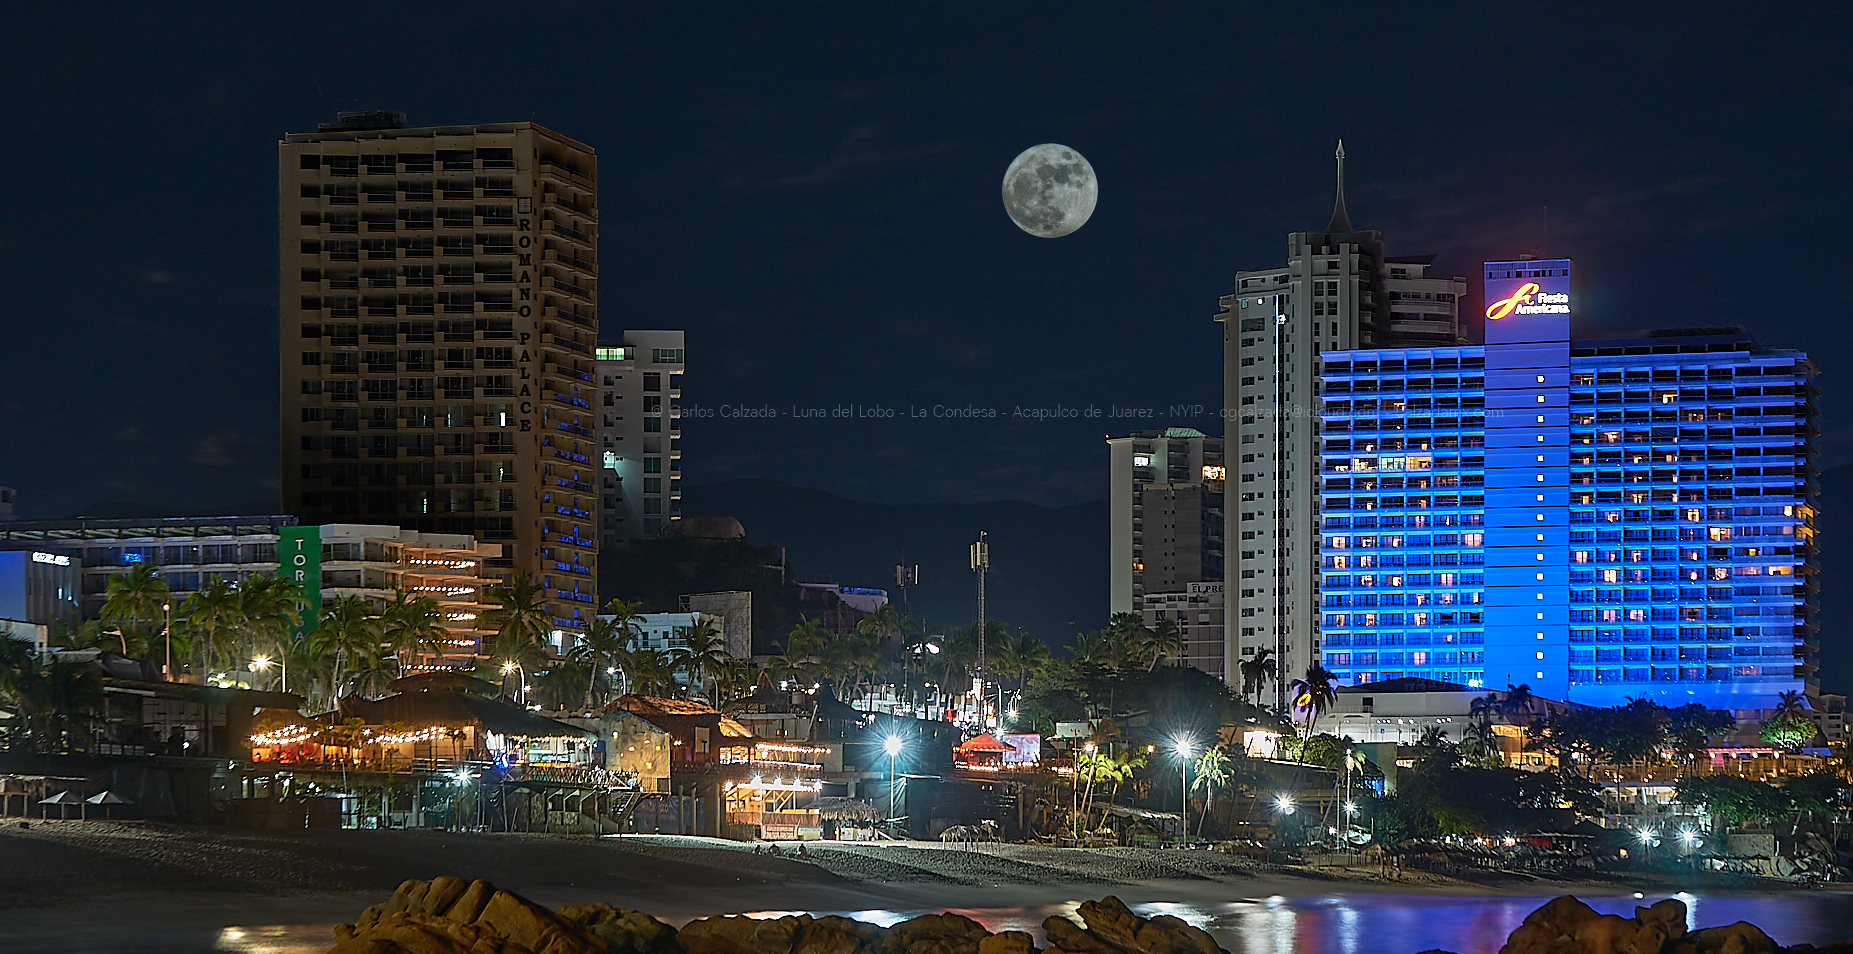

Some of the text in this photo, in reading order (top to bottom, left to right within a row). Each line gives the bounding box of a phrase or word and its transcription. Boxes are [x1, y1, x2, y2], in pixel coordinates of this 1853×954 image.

[1537, 292, 1569, 304] Fiesta
[518, 218, 532, 432] ROMANO PALACE
[1192, 585, 1203, 593] EL
